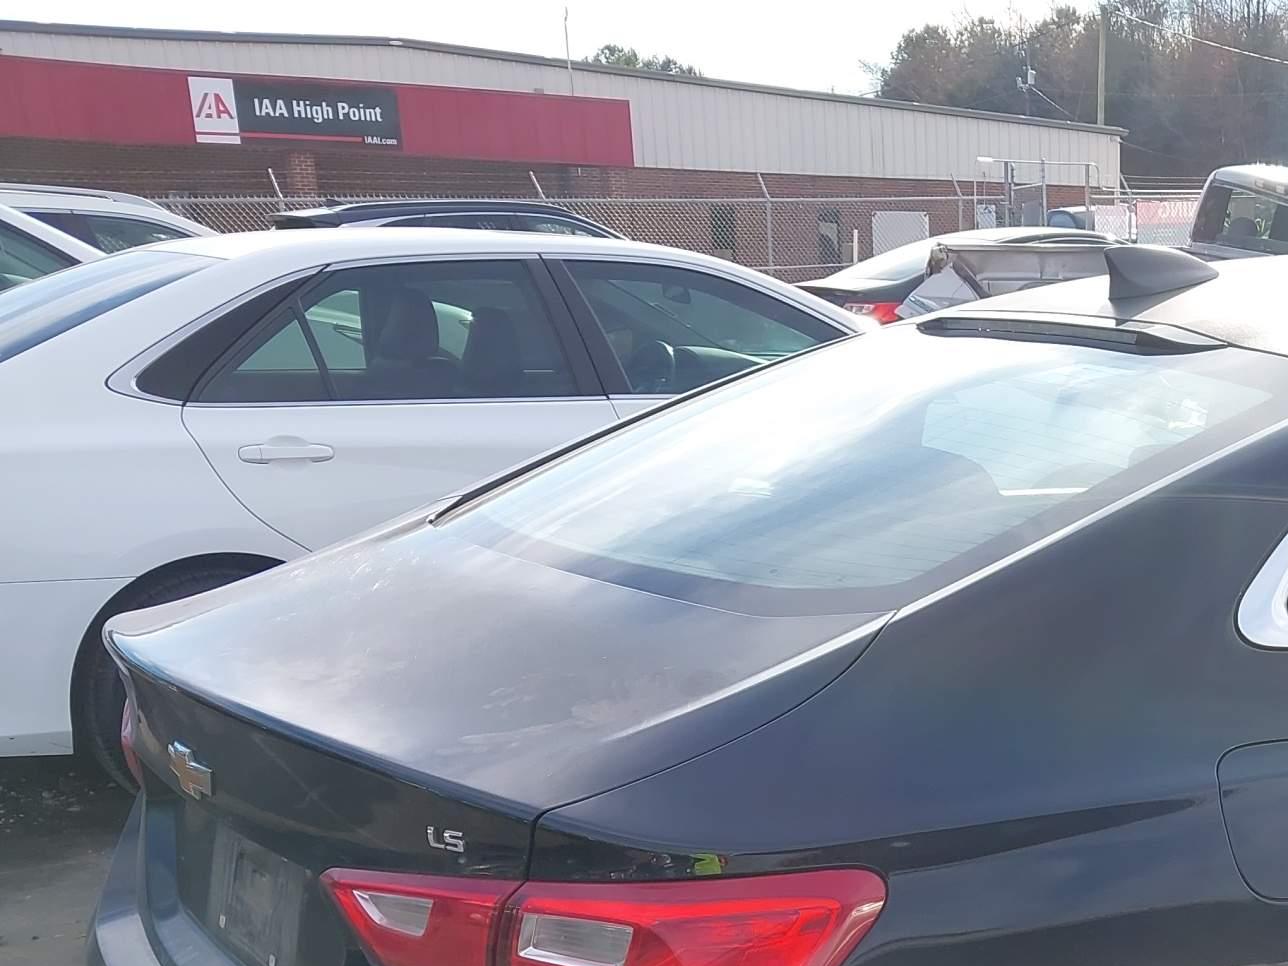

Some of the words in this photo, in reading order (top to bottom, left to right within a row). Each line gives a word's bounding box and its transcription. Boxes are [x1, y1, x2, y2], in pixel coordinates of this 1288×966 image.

[253, 98, 289, 118] IAA
[292, 99, 334, 123] High
[336, 102, 384, 122] Point
[426, 825, 465, 853] LS
